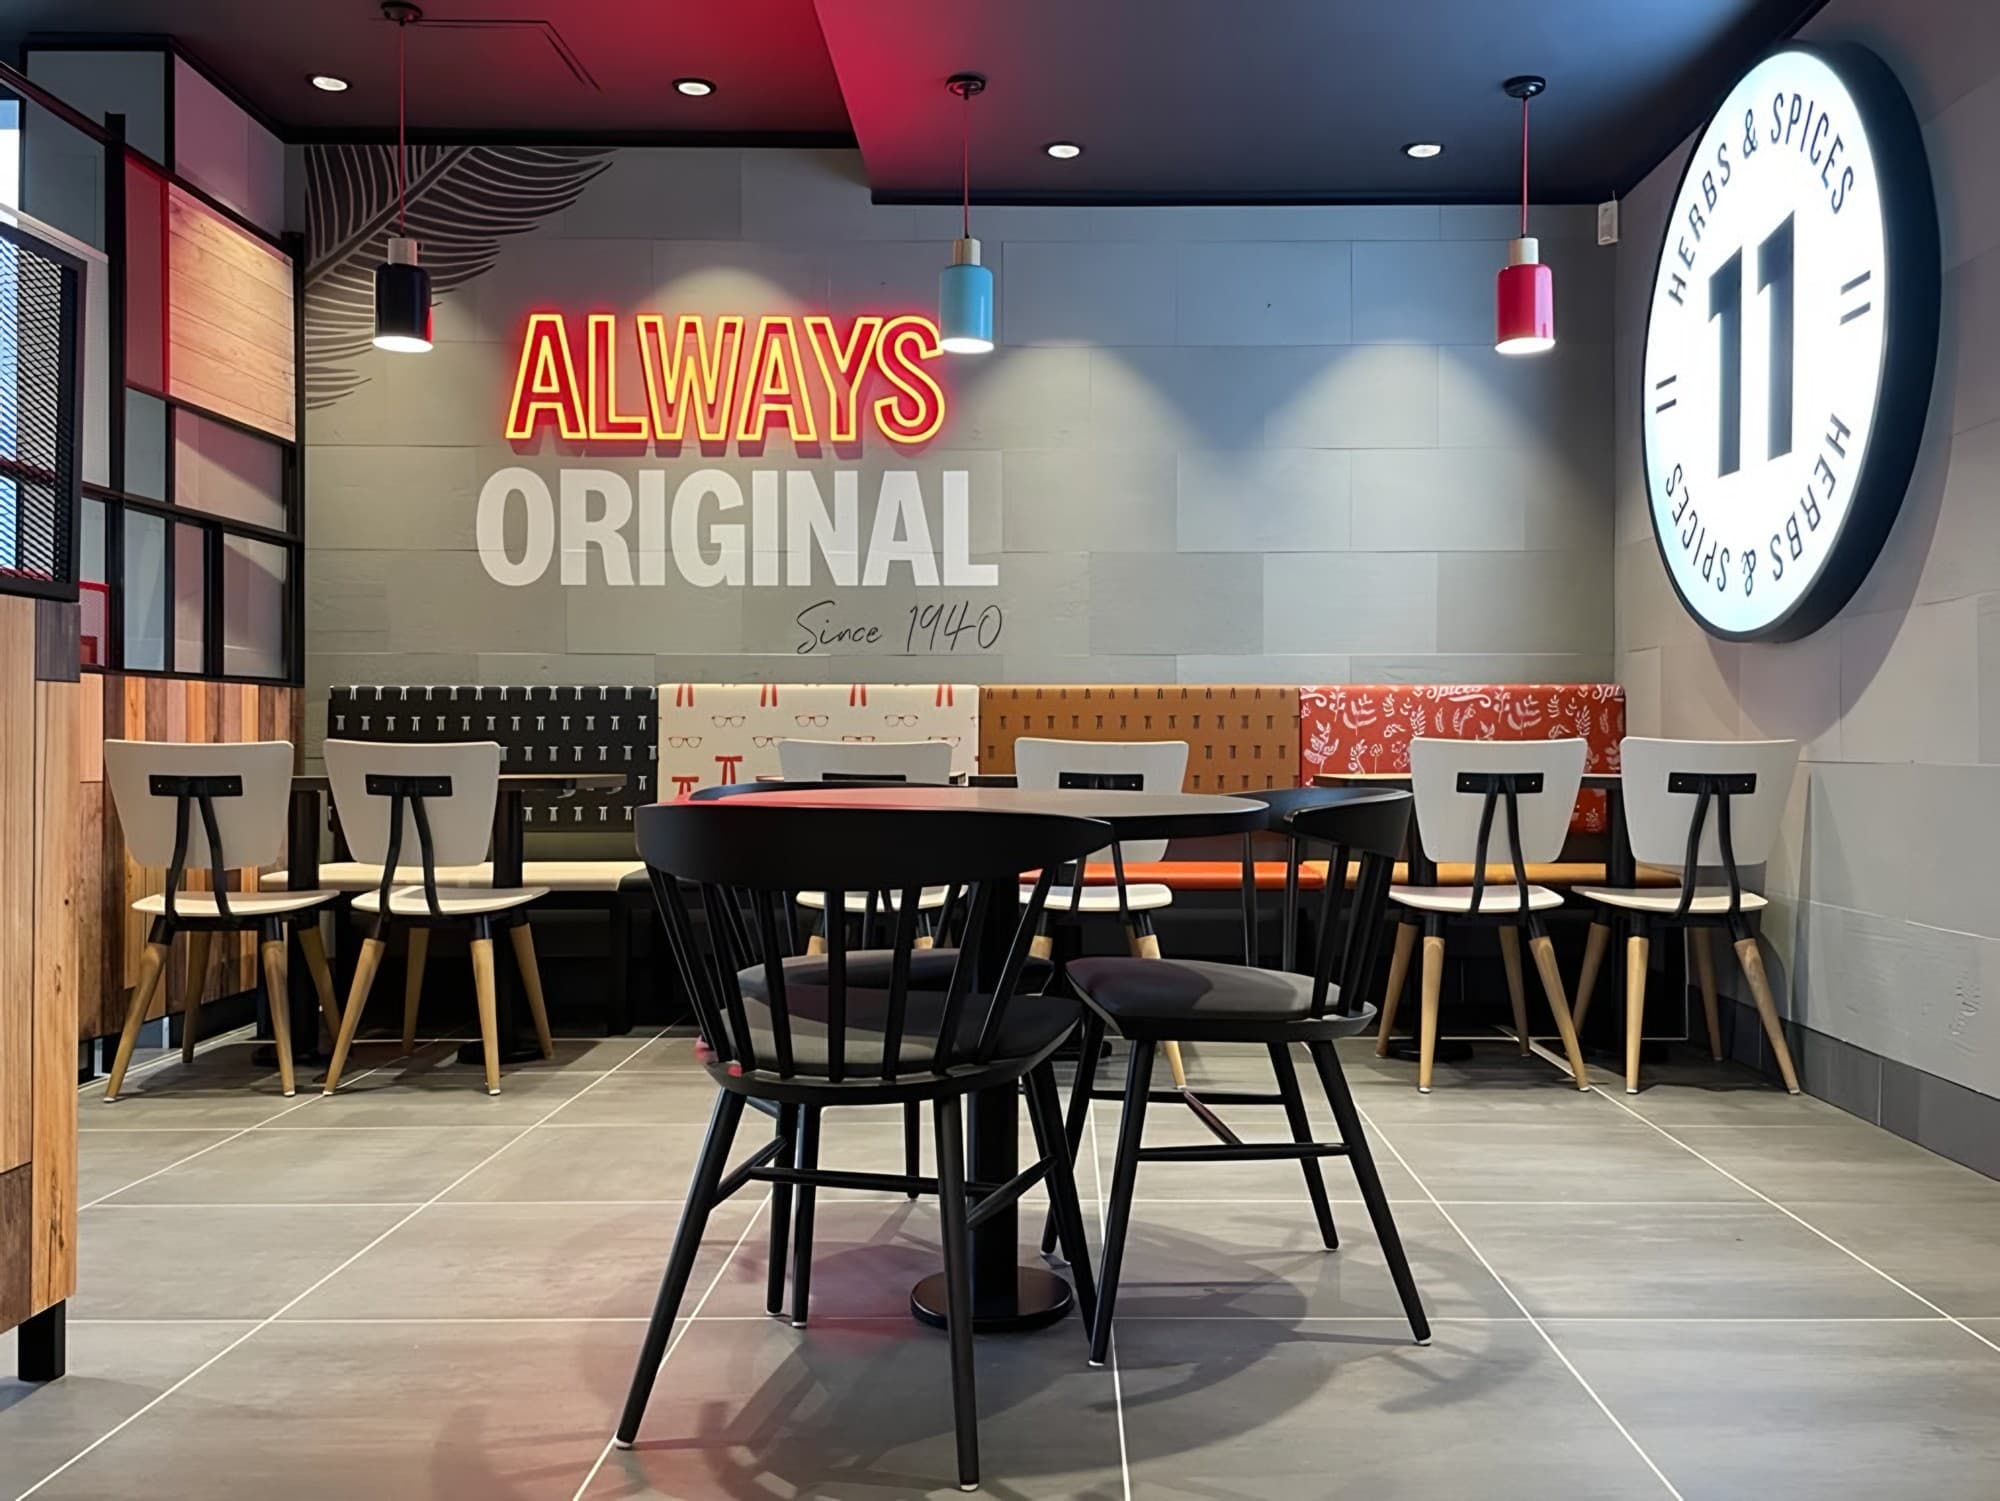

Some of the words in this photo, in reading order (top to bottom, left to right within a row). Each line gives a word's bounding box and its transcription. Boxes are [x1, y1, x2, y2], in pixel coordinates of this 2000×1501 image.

[1668, 142, 1731, 306] HERBS
[1743, 109, 1757, 159] &
[1770, 92, 1854, 214] SPICES
[505, 314, 946, 443] ALWAYS
[1709, 210, 1795, 479] 11
[476, 467, 999, 587] ORIGINAL
[1666, 463, 1730, 592] SPICES
[1769, 413, 1851, 581] HERBS
[796, 600, 883, 655] Since
[906, 601, 1003, 655] 1940
[1741, 549, 1757, 597] &
